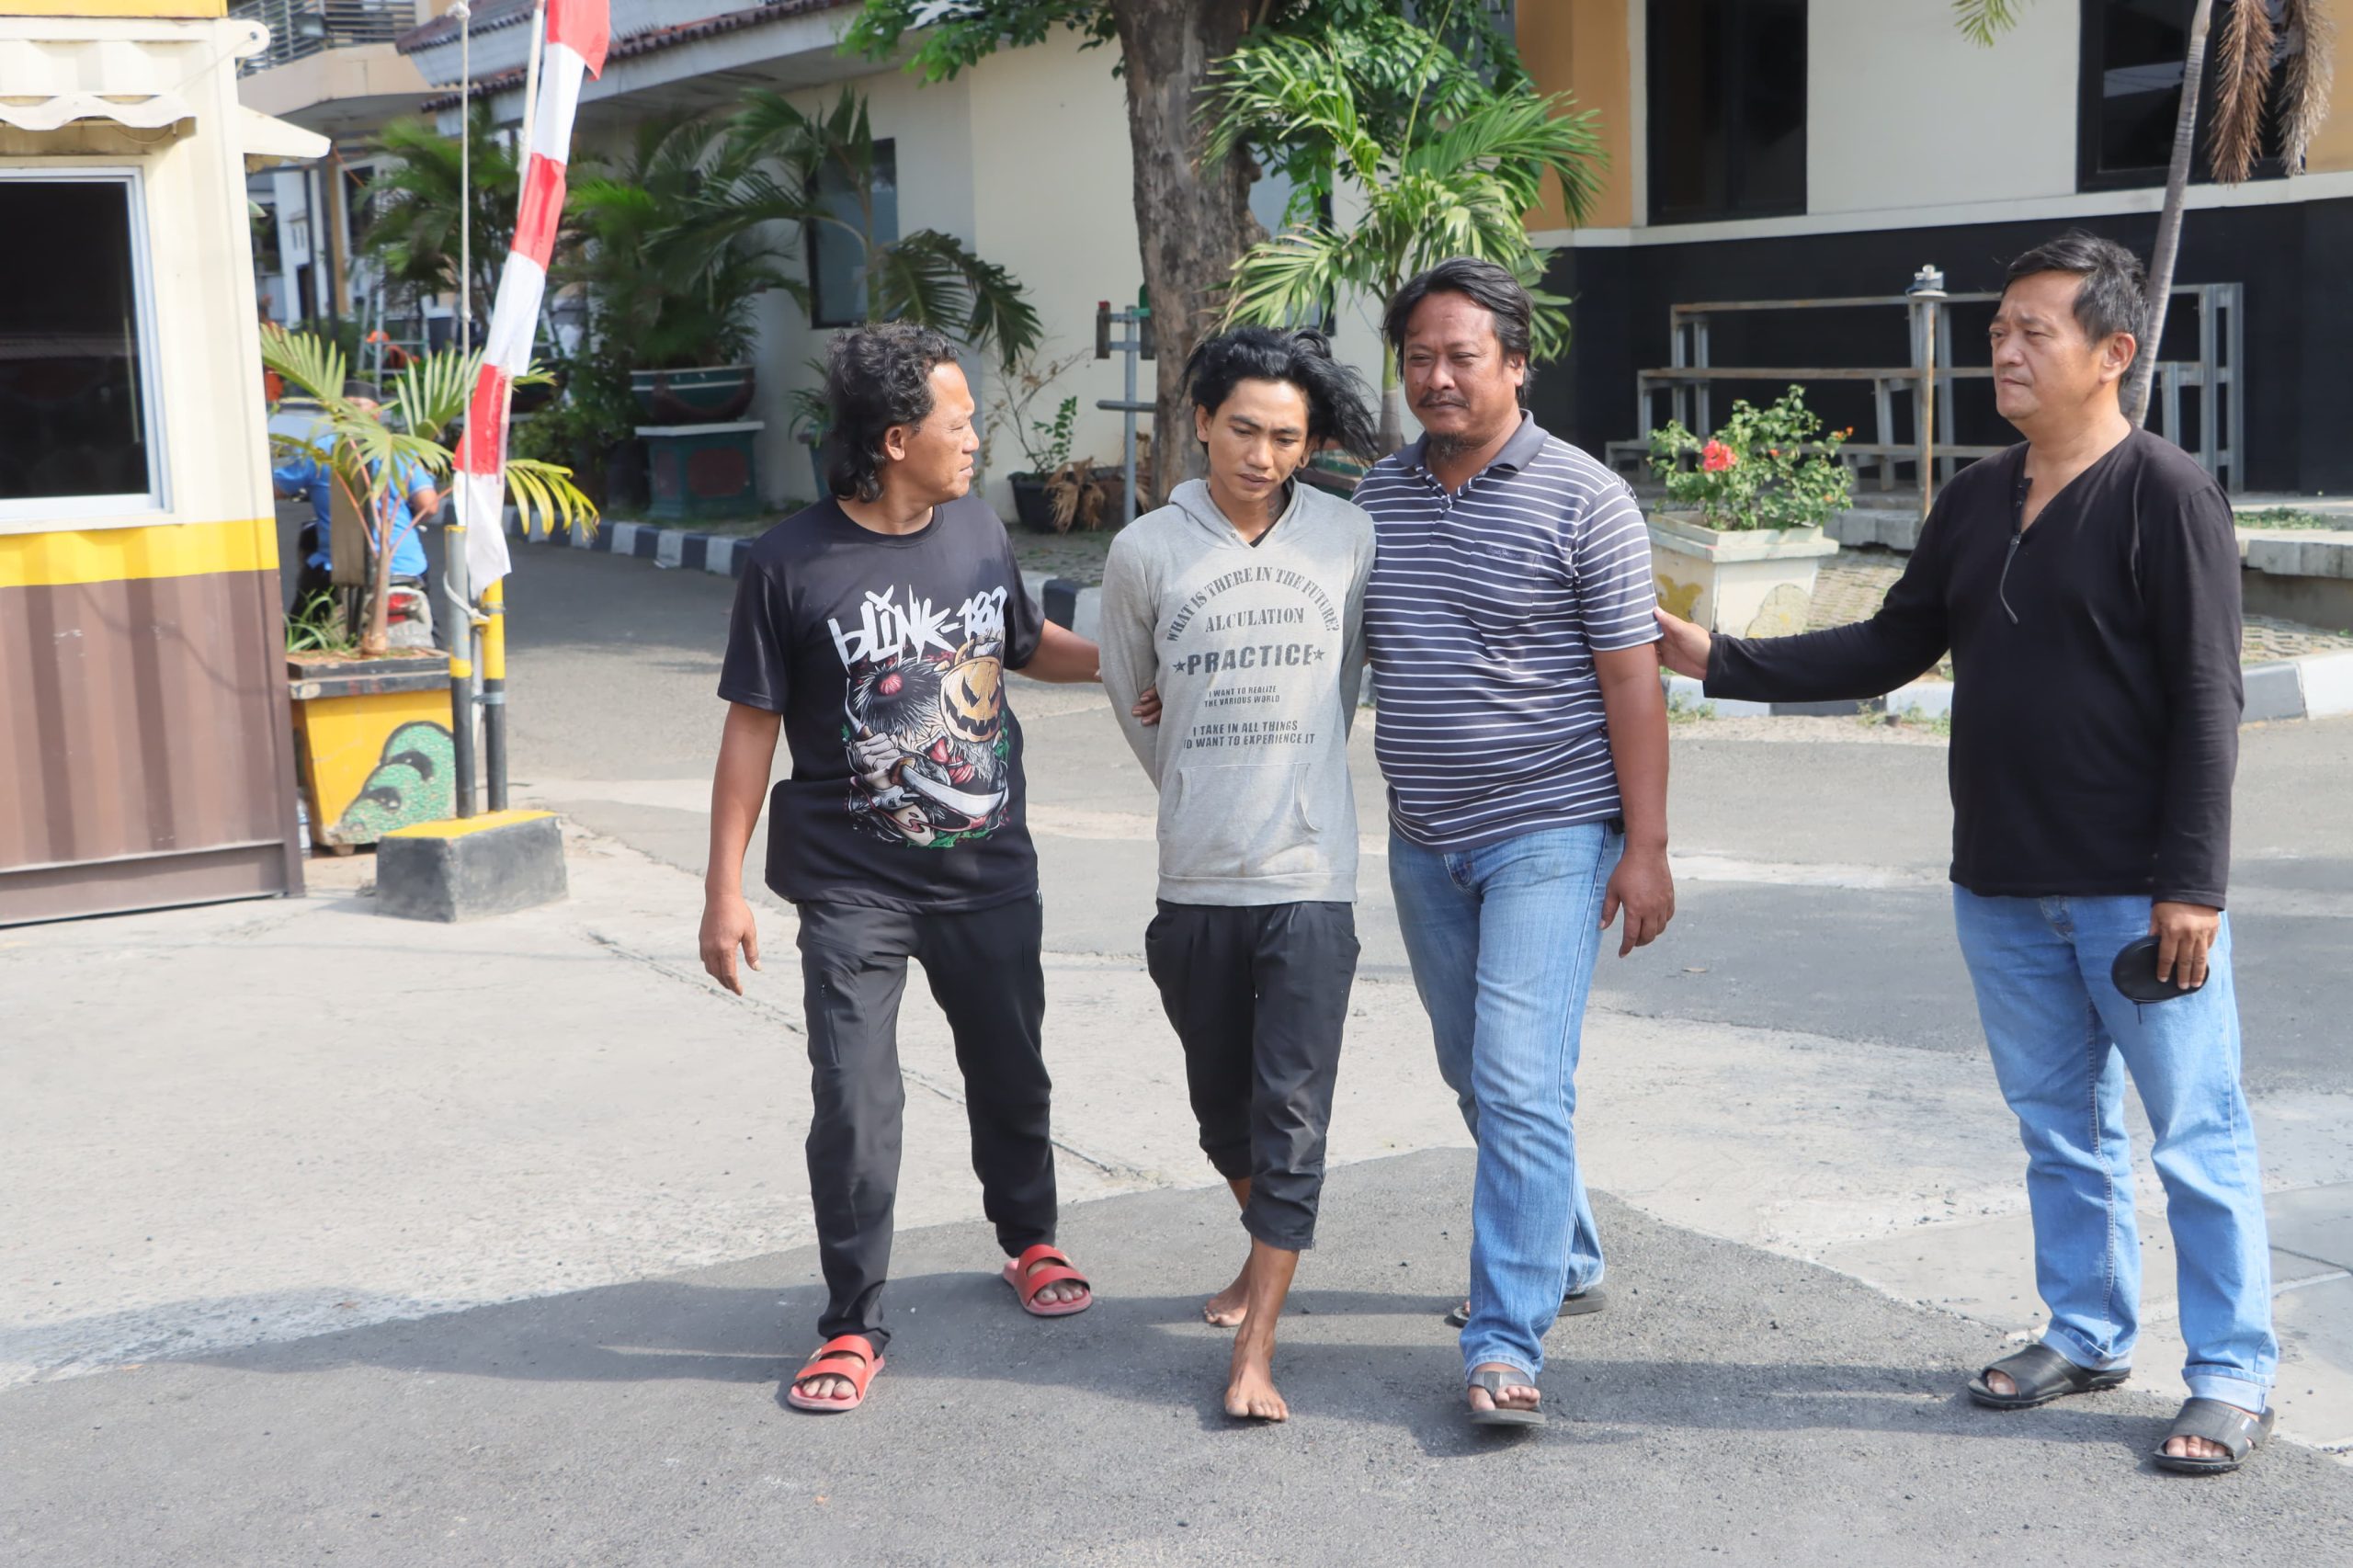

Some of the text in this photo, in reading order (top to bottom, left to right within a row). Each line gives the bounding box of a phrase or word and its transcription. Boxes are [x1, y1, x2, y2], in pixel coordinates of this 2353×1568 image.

[1166, 566, 1340, 642] WHAT IS THERE IN THE FUTURE?
[1187, 643, 1314, 676] PRACTICE
[1213, 687, 1235, 698] WANT
[1237, 686, 1246, 695] TO
[1248, 685, 1278, 695] REALIZE
[1204, 694, 1280, 708] THE VARIOUS WORLD
[1199, 723, 1225, 735] TAKE
[1227, 722, 1239, 733] IN
[1242, 722, 1259, 733] ALL
[1262, 720, 1299, 733] THINGS
[1196, 736, 1225, 748] WANT
[1227, 735, 1241, 746] TO
[1243, 733, 1302, 745] EXPERIENCE
[1304, 733, 1316, 744] IT
